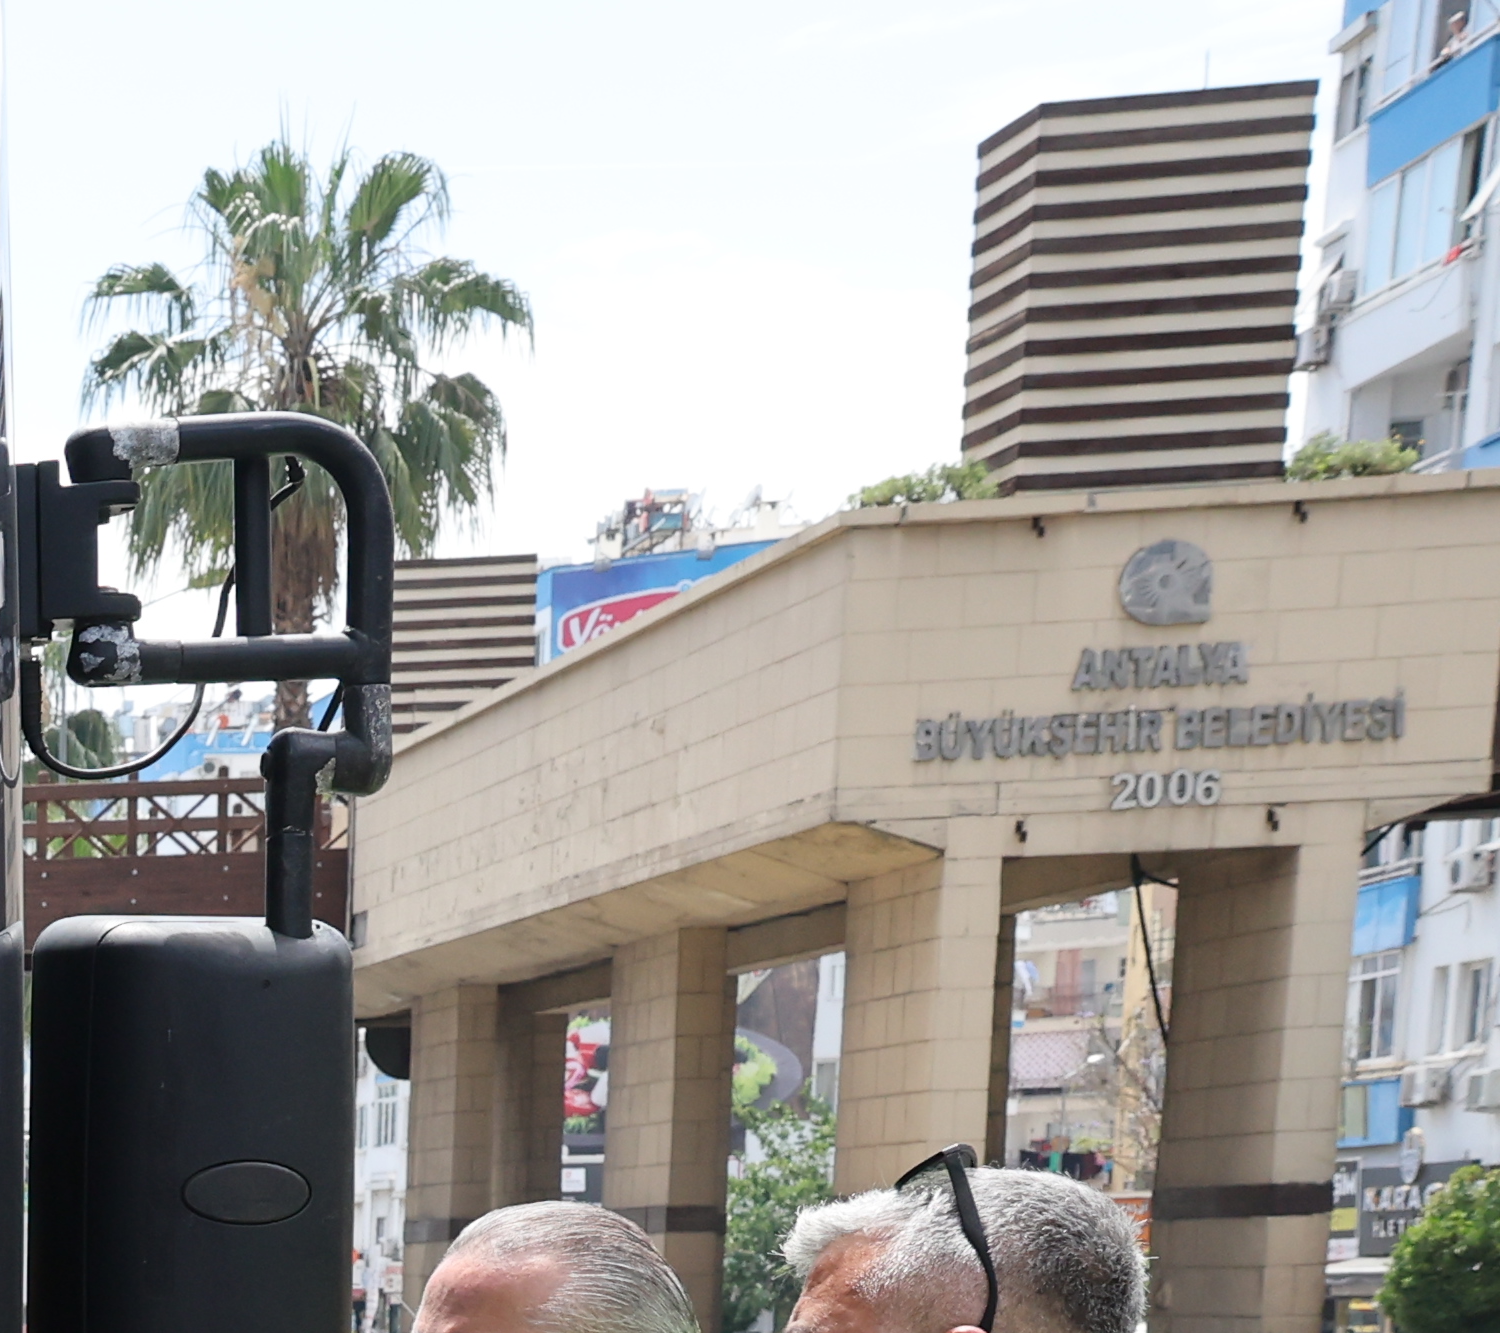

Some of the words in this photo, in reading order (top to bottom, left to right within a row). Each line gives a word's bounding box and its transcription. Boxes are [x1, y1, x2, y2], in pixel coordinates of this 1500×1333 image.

[1071, 642, 1248, 691] ANTALYA
[912, 705, 1163, 763] BÜYÜKŞEHİR
[1174, 690, 1406, 751] BELEDİYESİ
[1111, 768, 1221, 811] 2006
